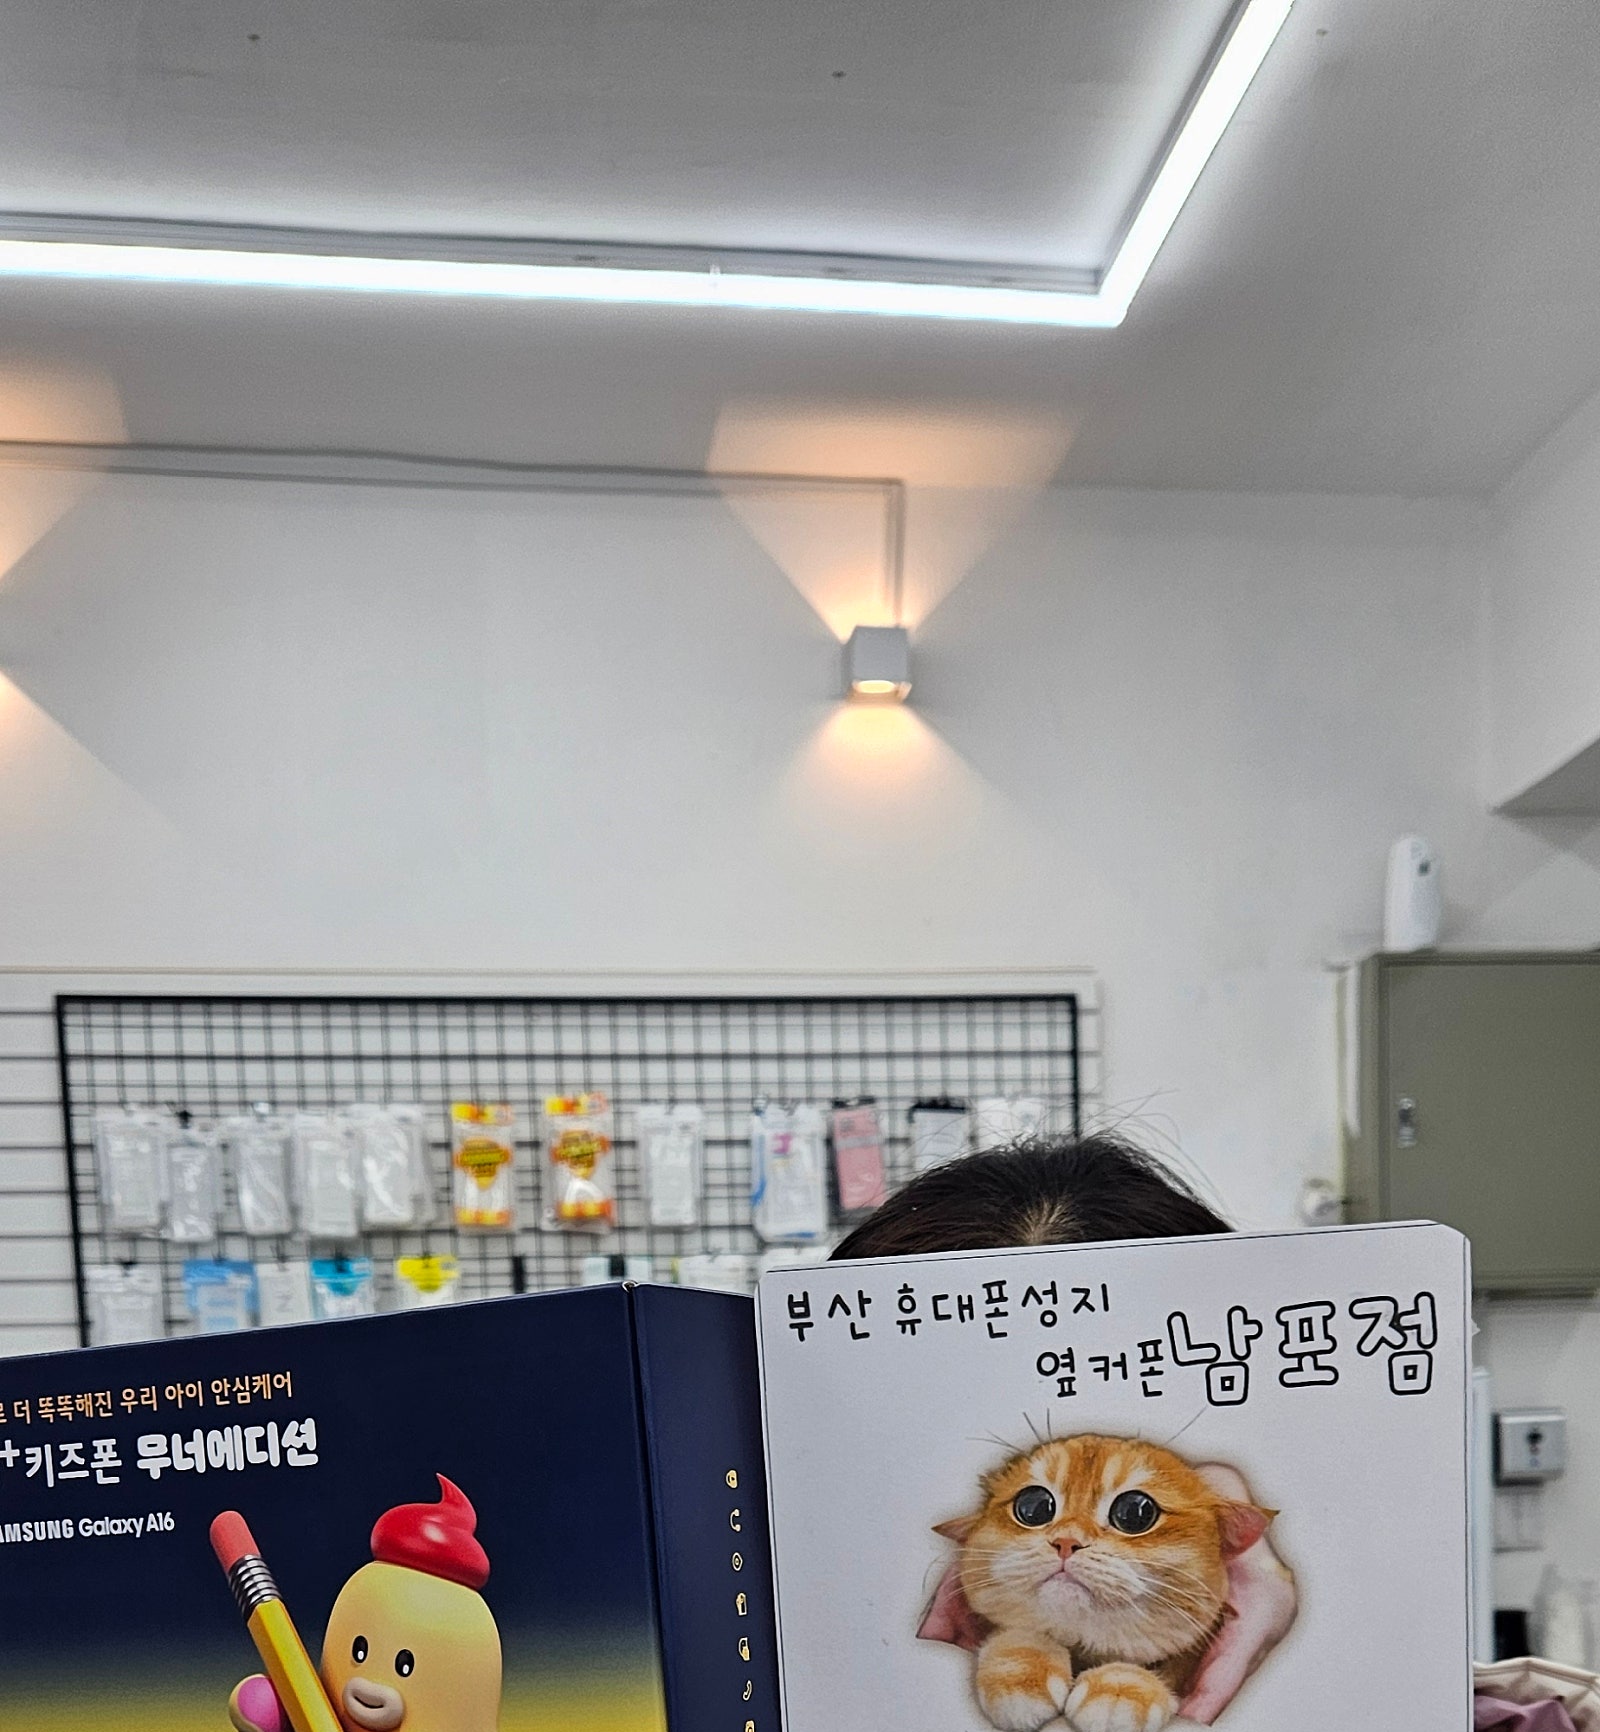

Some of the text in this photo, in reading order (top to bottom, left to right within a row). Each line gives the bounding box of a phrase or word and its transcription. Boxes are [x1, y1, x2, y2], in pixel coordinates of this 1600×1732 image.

[786, 1280, 1111, 1342] 부산 휴대폰성지
[13, 1399, 31, 1424] 더
[38, 1390, 113, 1423] 똑똑해진
[120, 1385, 158, 1414] 우리
[164, 1380, 204, 1409] 아이
[210, 1371, 294, 1404] 안심케어
[136, 1417, 319, 1480] 무너에디션
[78, 1515, 144, 1539] Galaxy
[146, 1511, 175, 1533] A16
